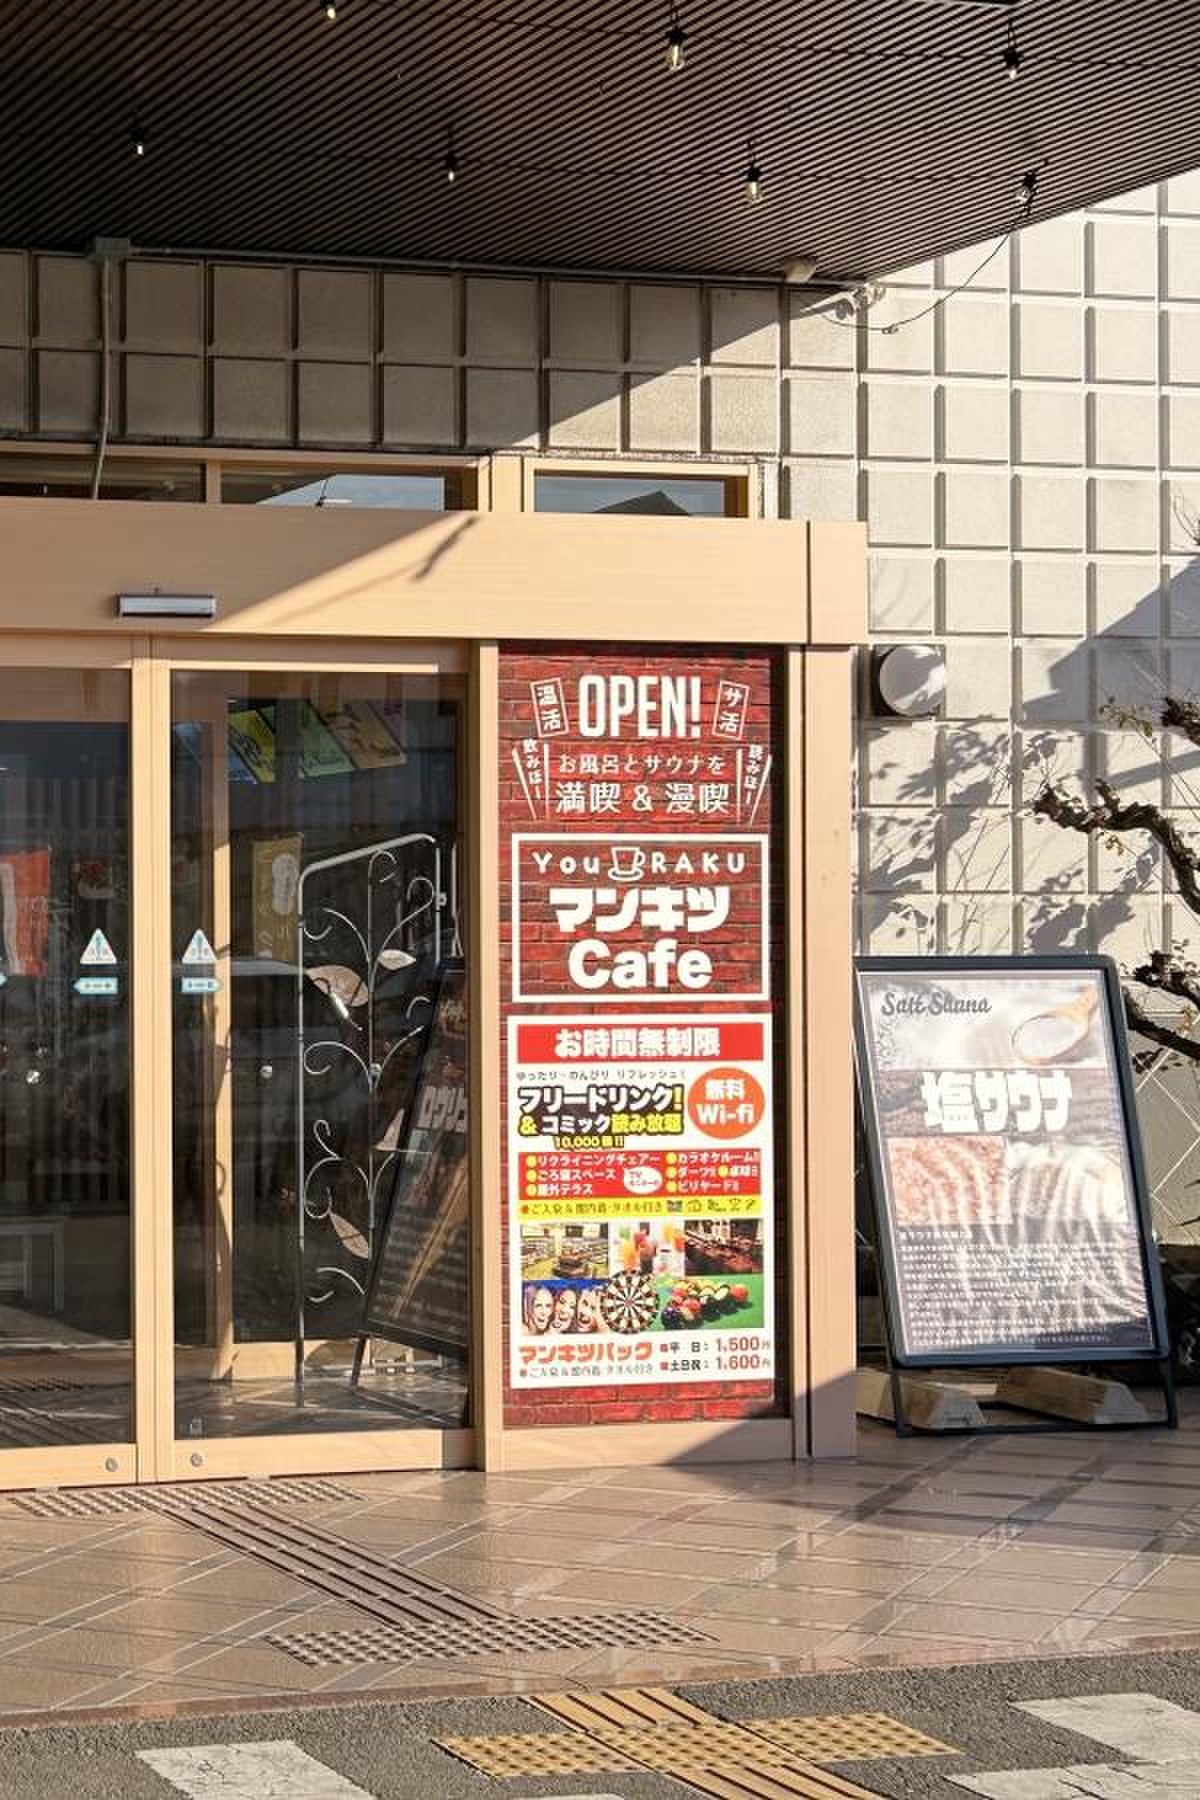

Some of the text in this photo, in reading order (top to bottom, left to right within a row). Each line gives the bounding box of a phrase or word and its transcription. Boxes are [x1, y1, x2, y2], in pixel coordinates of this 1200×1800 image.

[579, 675, 701, 737] OPEN!
[719, 687, 743, 732] サ活
[559, 754, 726, 775] お風呂とサウナを
[555, 782, 730, 814] 満喫 & 漫喫
[532, 852, 745, 874] You RAKU
[550, 886, 730, 932] マンキツ
[567, 938, 713, 989] Cafe
[555, 1027, 721, 1057] お時間無制限
[518, 1084, 685, 1113] フリードリンク!
[921, 1070, 1073, 1133] 塩サウナ
[518, 1342, 653, 1366] マンキツパック
